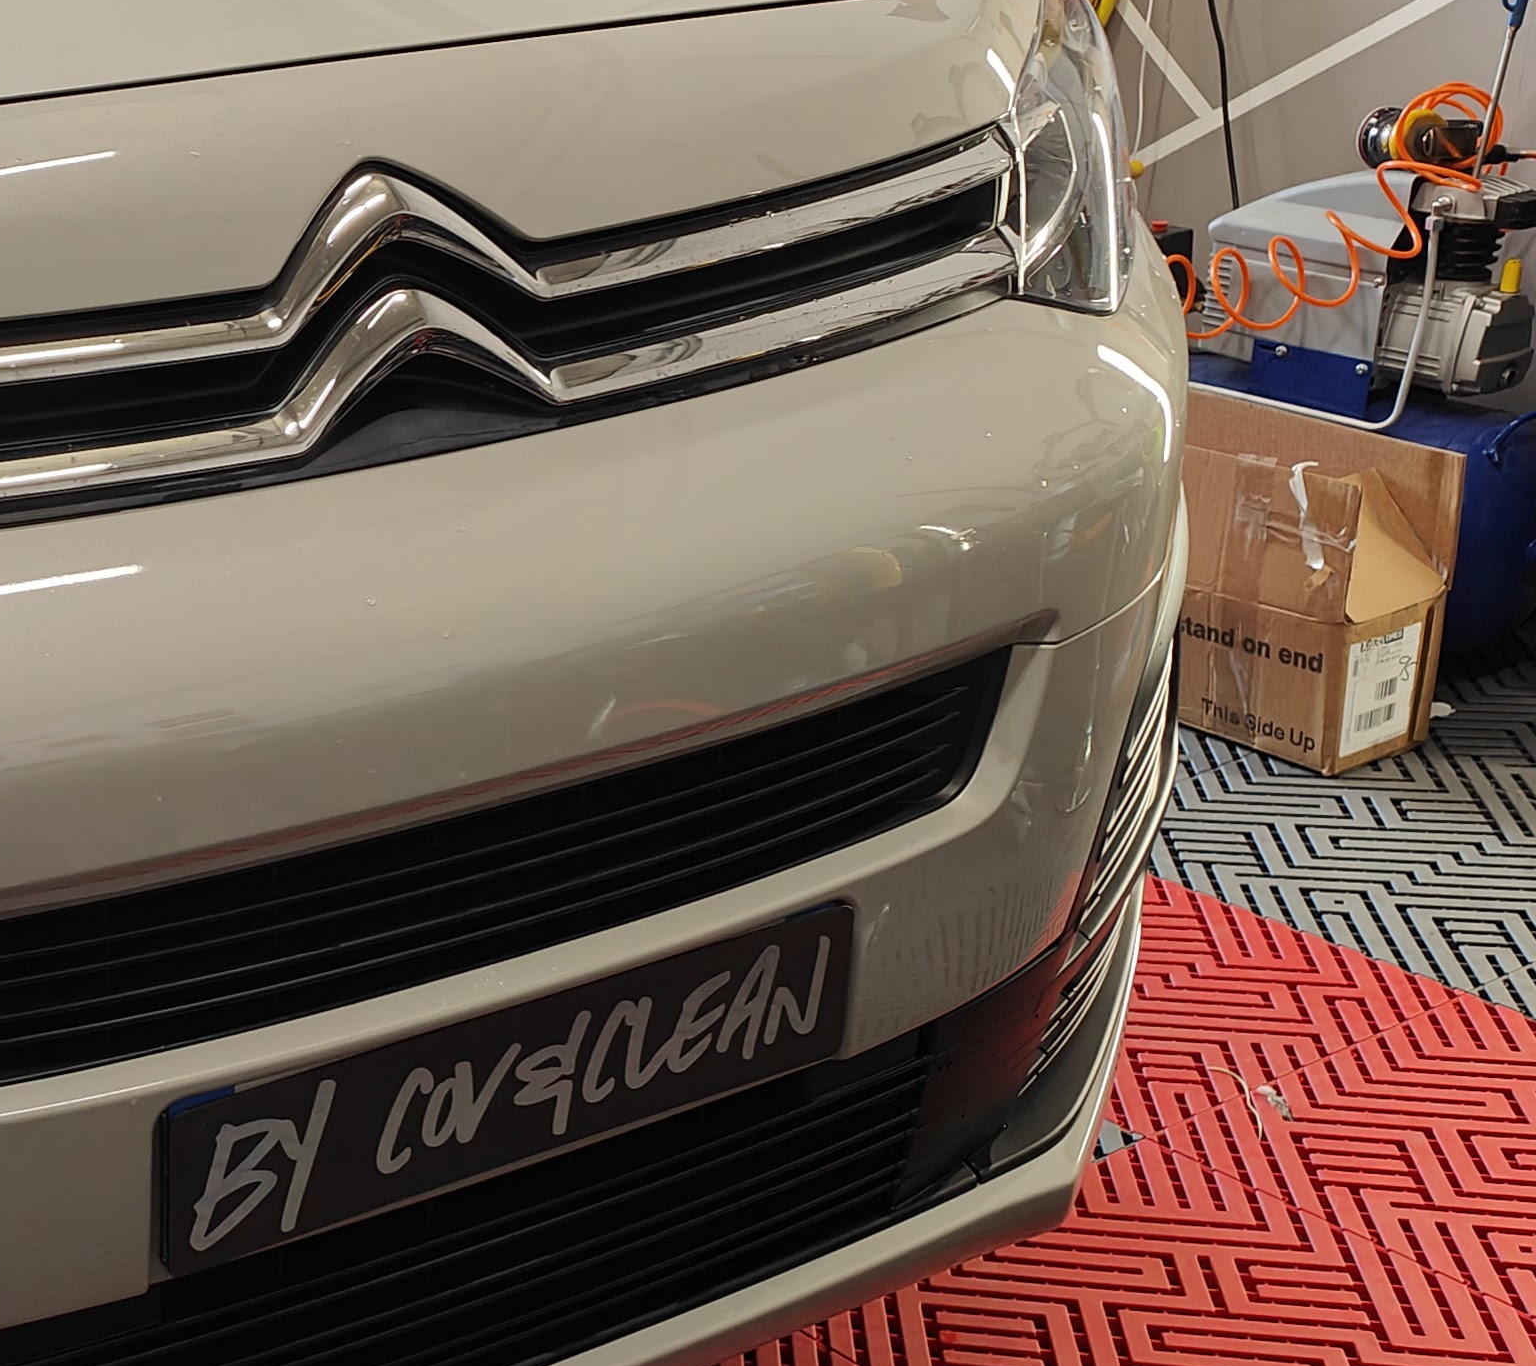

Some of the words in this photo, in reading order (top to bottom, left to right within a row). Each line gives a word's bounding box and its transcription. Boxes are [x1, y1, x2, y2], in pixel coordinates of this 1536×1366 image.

[1241, 637, 1271, 660] on
[1278, 647, 1324, 674] end
[1201, 697, 1240, 726] This
[1245, 713, 1286, 741] Side
[1289, 727, 1316, 753] Up
[189, 1079, 337, 1252] BY
